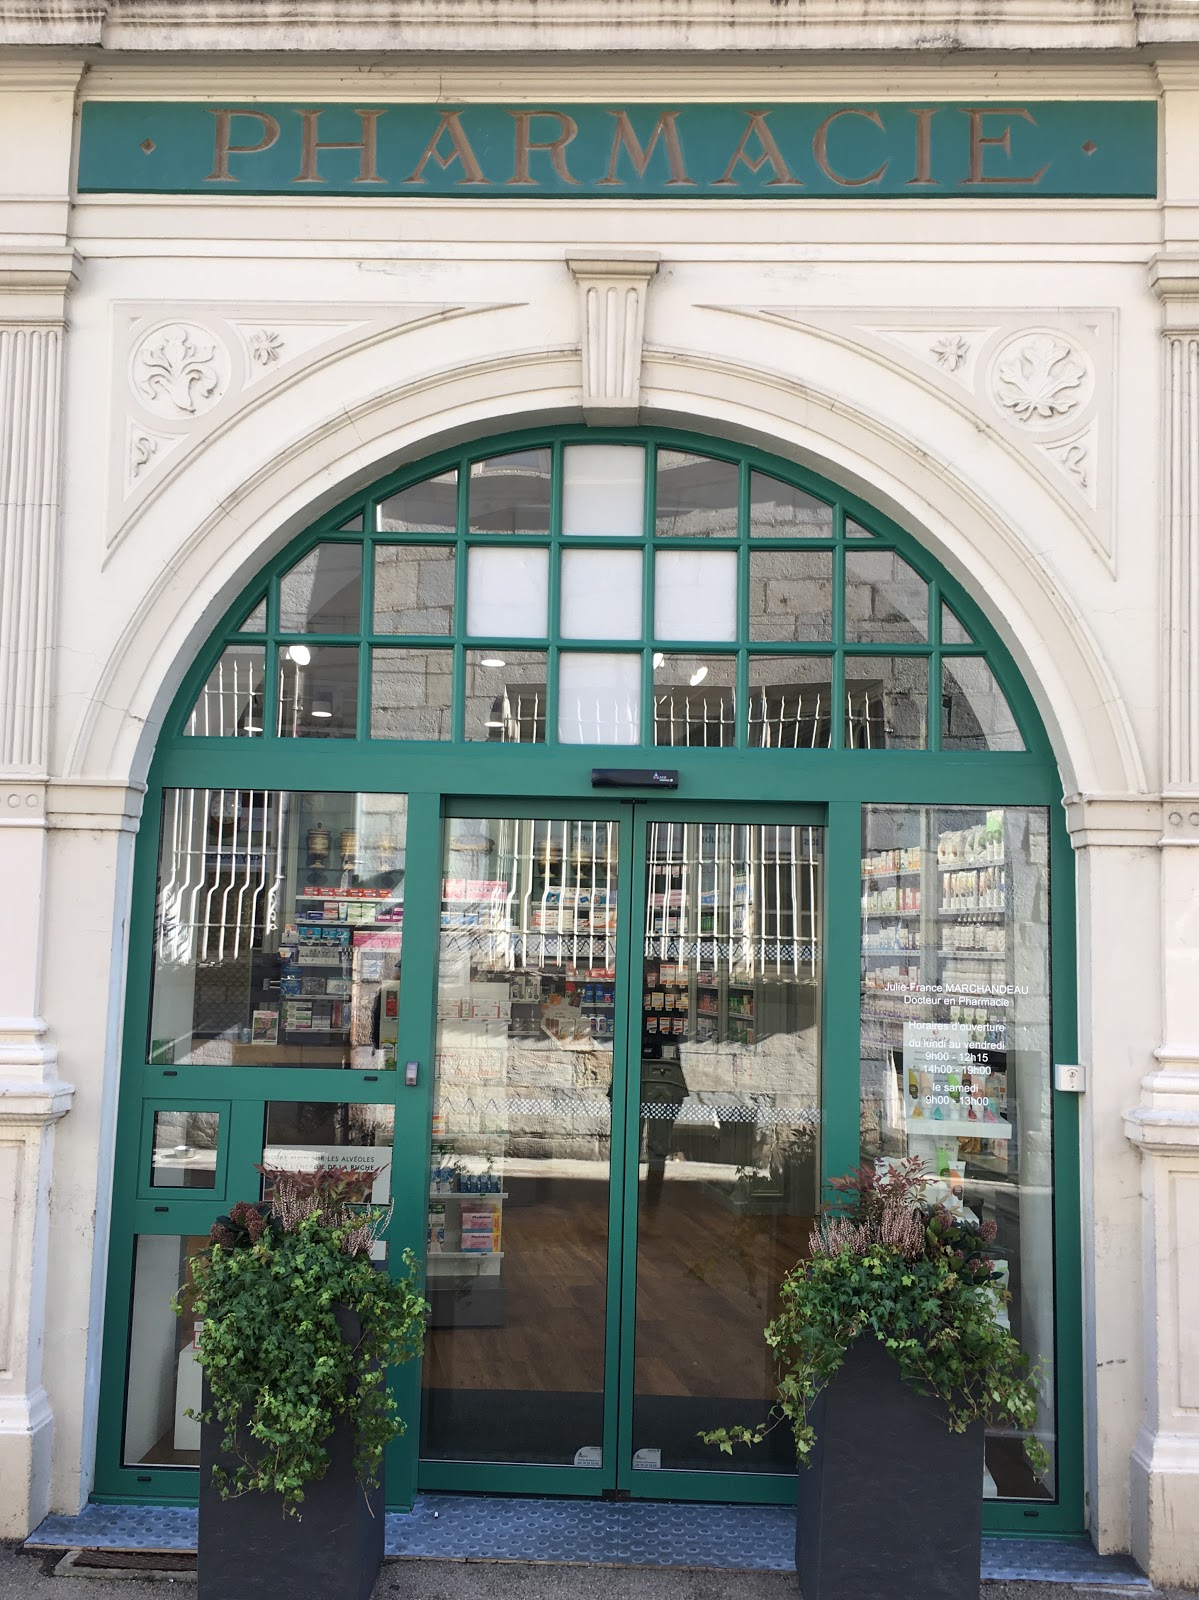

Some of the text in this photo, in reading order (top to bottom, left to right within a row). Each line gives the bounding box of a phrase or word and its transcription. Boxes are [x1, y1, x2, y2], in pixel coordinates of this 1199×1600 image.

[202, 108, 1050, 186] PHARMACIE
[884, 983, 1029, 995] Julie-France MARCHANDEAU
[904, 995, 941, 1005] Docteur
[958, 996, 1010, 1007] Pharmacie
[908, 1021, 1005, 1033] Horaires d'ouverture
[908, 1038, 921, 1047] du
[923, 1038, 947, 1049] lundi
[948, 1041, 961, 1049] au
[963, 1040, 1005, 1050] vendredi
[925, 1051, 950, 1061] 9h00
[959, 1052, 989, 1063] 12h15
[923, 1064, 952, 1075] 14h00
[962, 1066, 992, 1075] 19h00
[932, 1082, 979, 1093] le samedi
[925, 1095, 950, 1105] 9h00
[959, 1096, 989, 1106] 13h00
[341, 1154, 375, 1163] ALVÉOLES
